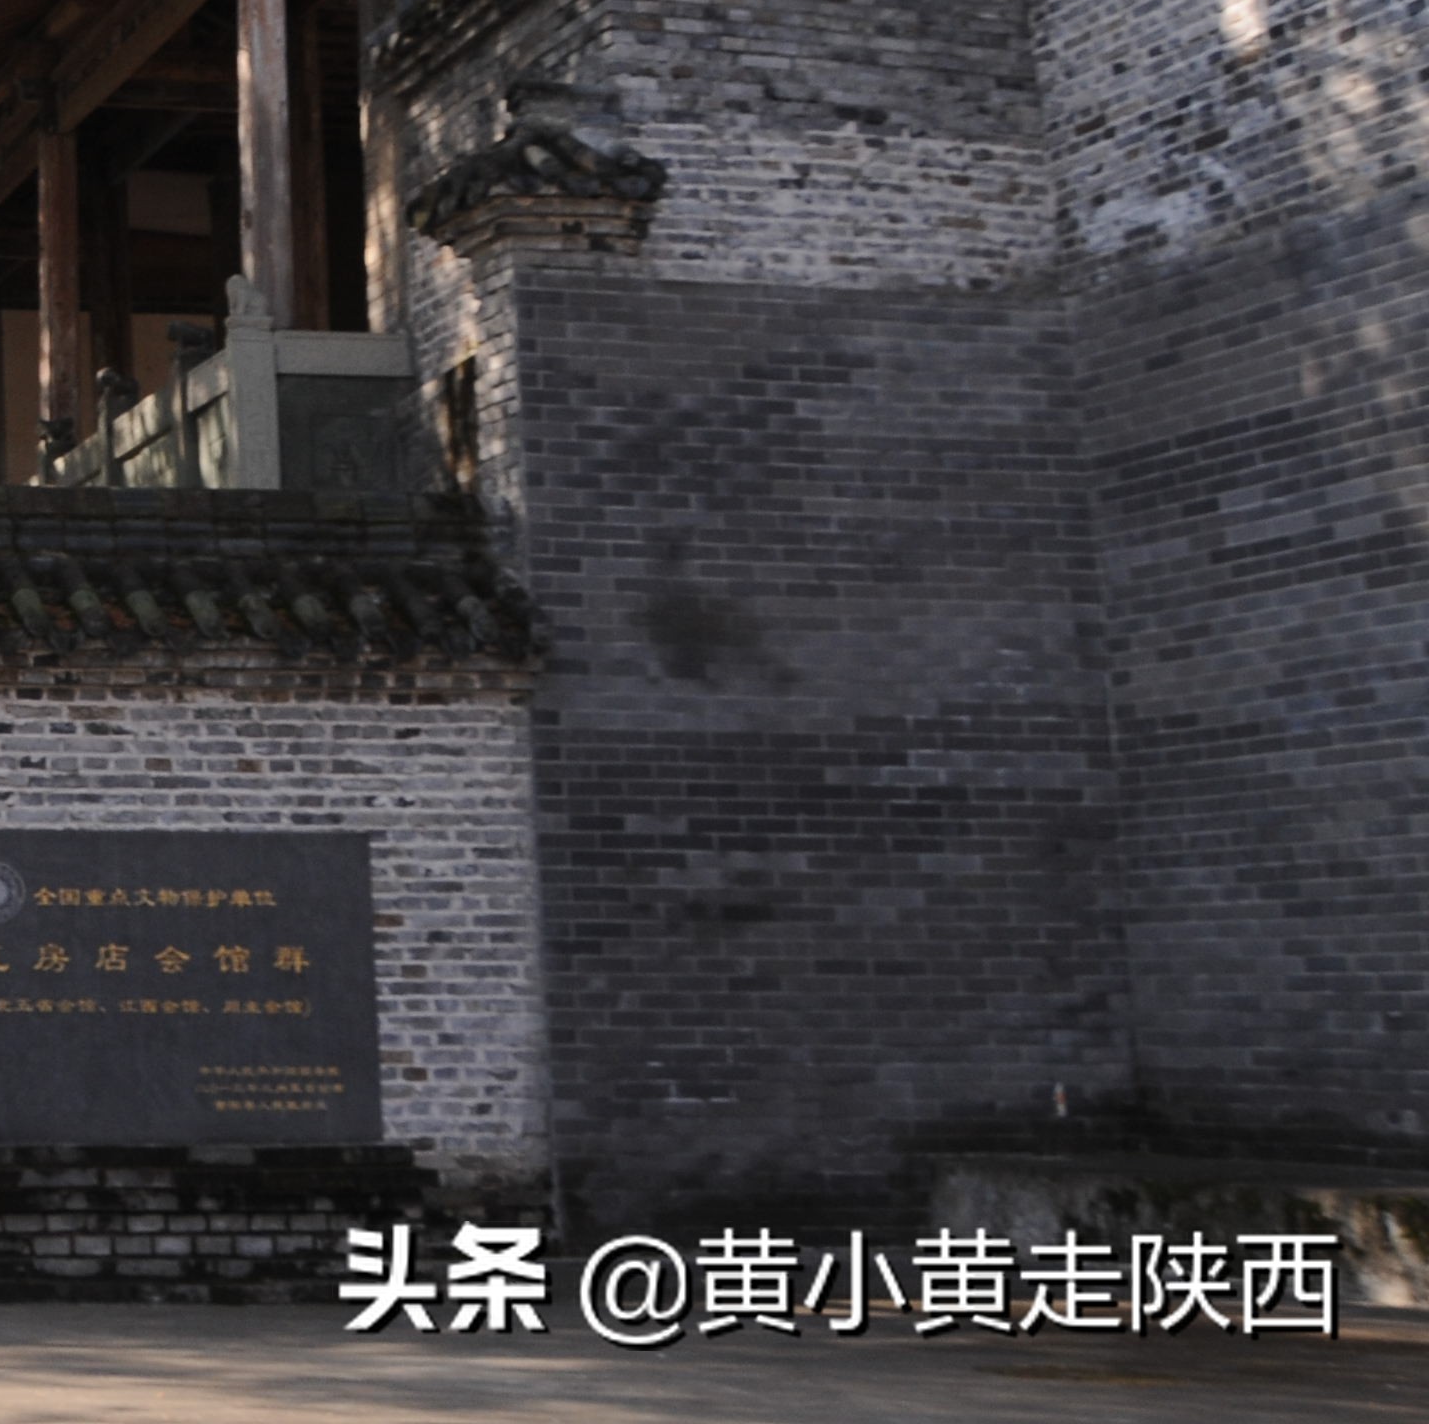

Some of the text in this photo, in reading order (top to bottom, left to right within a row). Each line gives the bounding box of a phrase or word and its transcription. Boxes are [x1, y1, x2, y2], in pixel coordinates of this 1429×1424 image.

[33, 887, 277, 908] 全国重点文物保护单位
